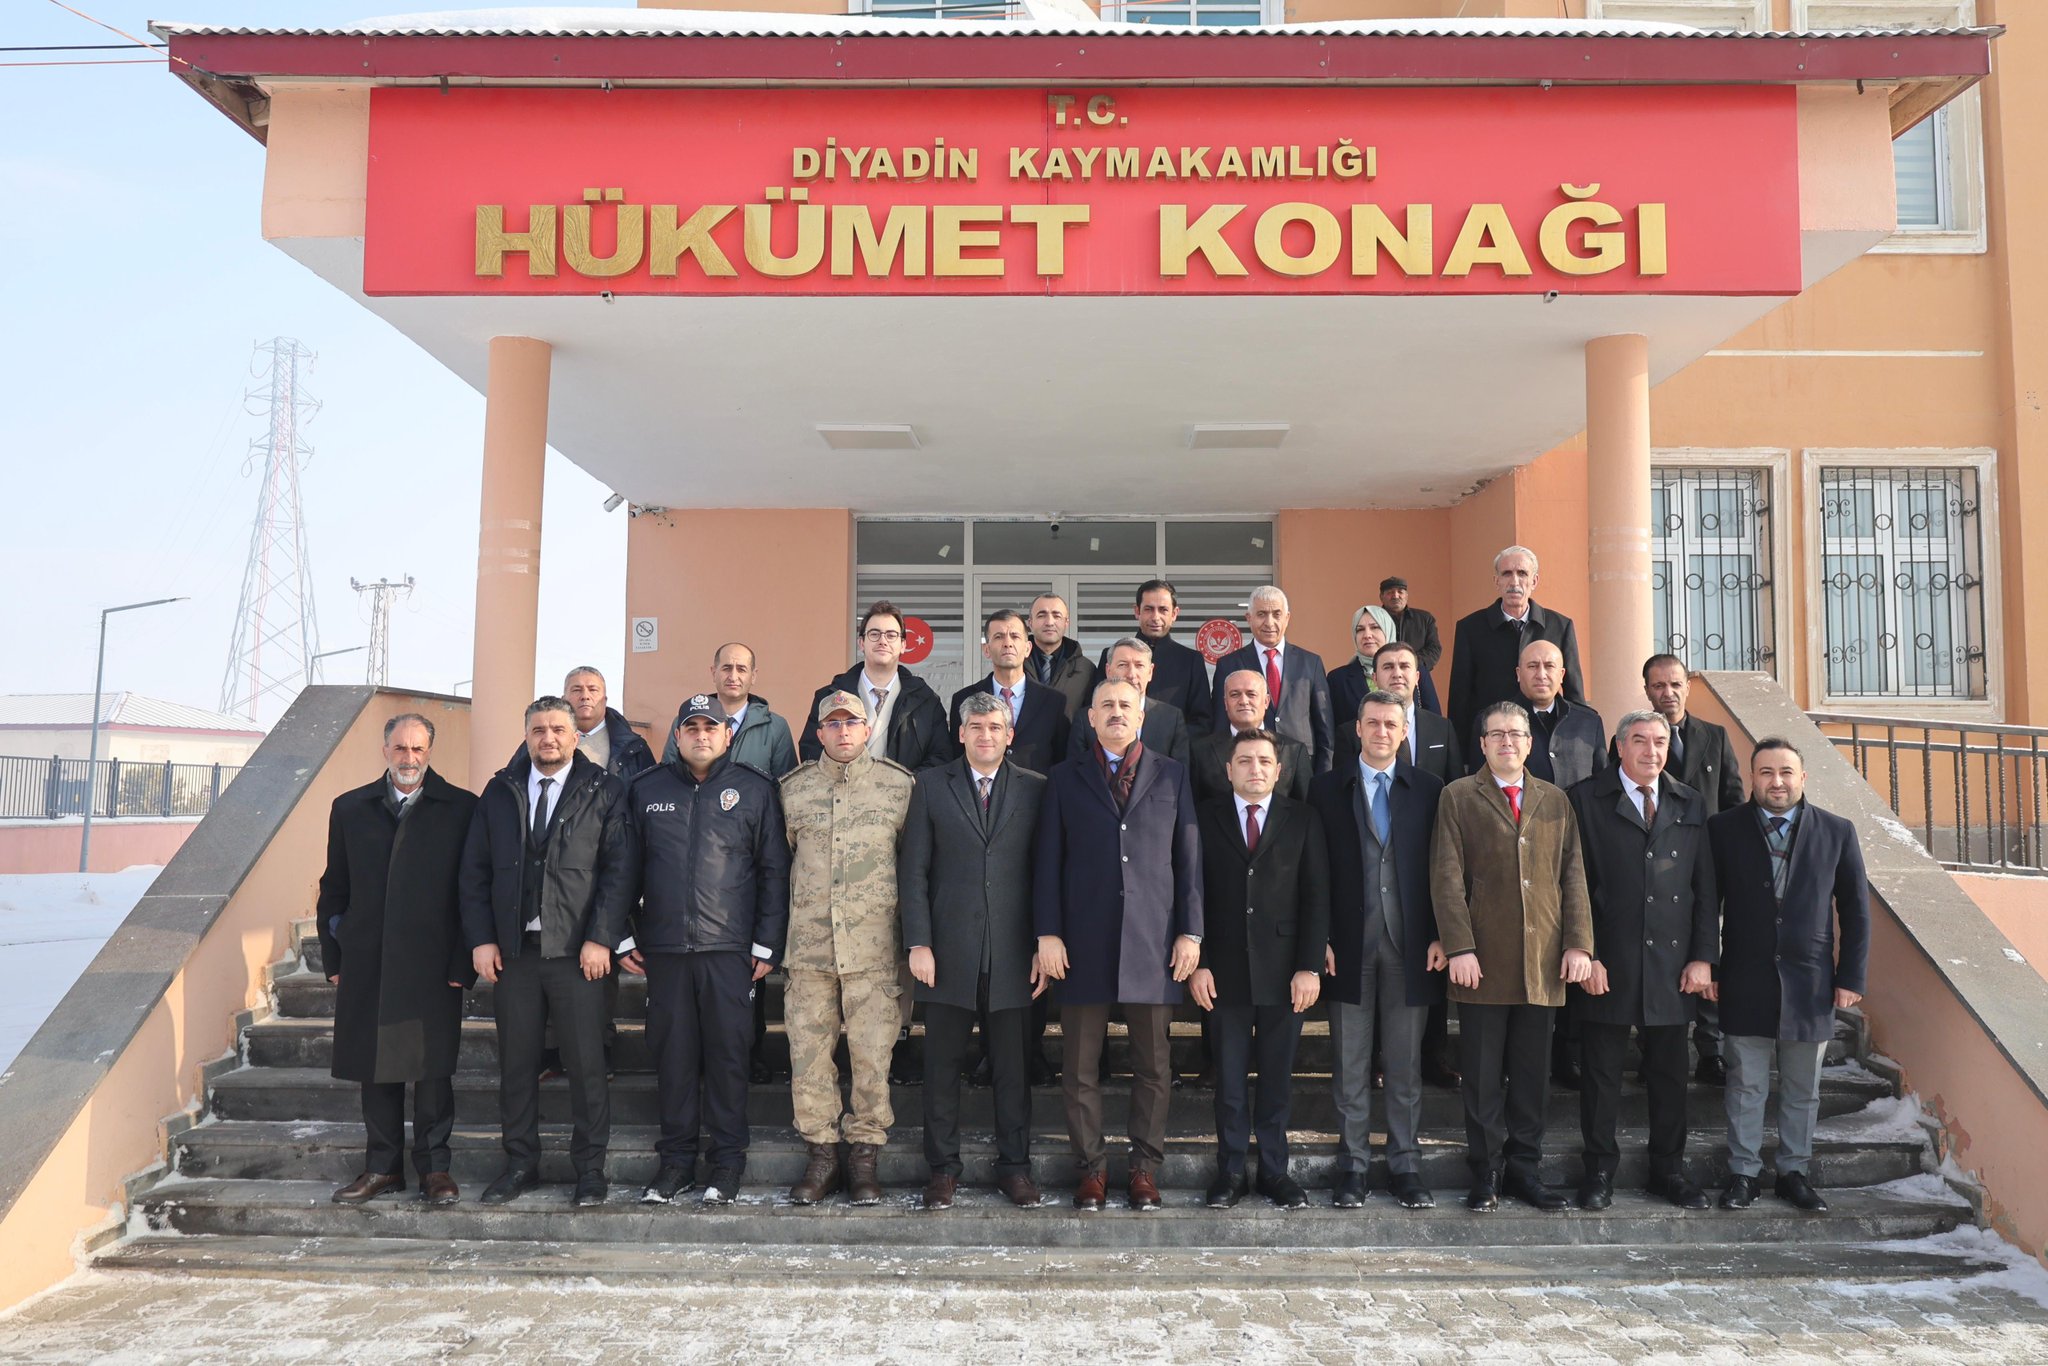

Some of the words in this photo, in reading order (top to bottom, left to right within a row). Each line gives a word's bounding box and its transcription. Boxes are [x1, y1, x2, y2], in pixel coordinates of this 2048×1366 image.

[1048, 94, 1128, 125] T.C.
[793, 137, 978, 180] DİYADİN
[1008, 138, 1377, 180] KAYMAKAMLIĞI
[475, 187, 1089, 276] HÜKÜMET
[1160, 183, 1667, 276] KONAĞI
